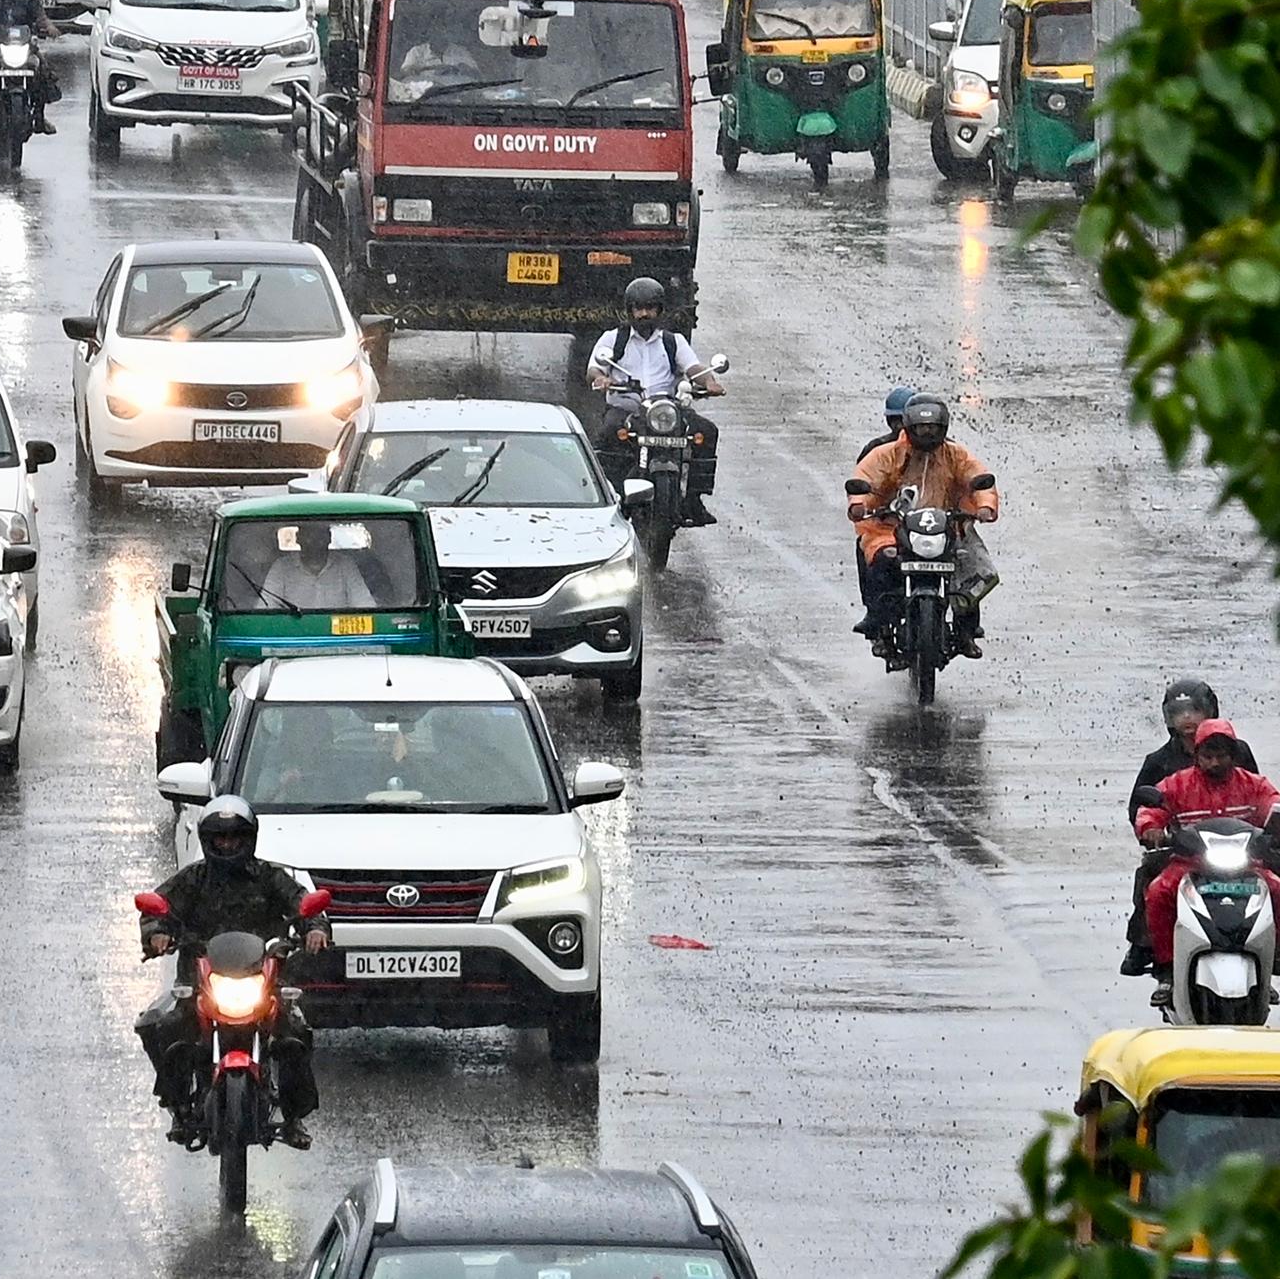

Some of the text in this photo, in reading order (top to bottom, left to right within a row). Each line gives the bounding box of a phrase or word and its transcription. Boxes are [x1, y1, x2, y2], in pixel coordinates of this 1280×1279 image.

[216, 67, 238, 77] INDIA
[475, 134, 597, 154] ON GOVT. DUTY
[514, 179, 553, 191] TATA
[518, 256, 553, 268] HR38A
